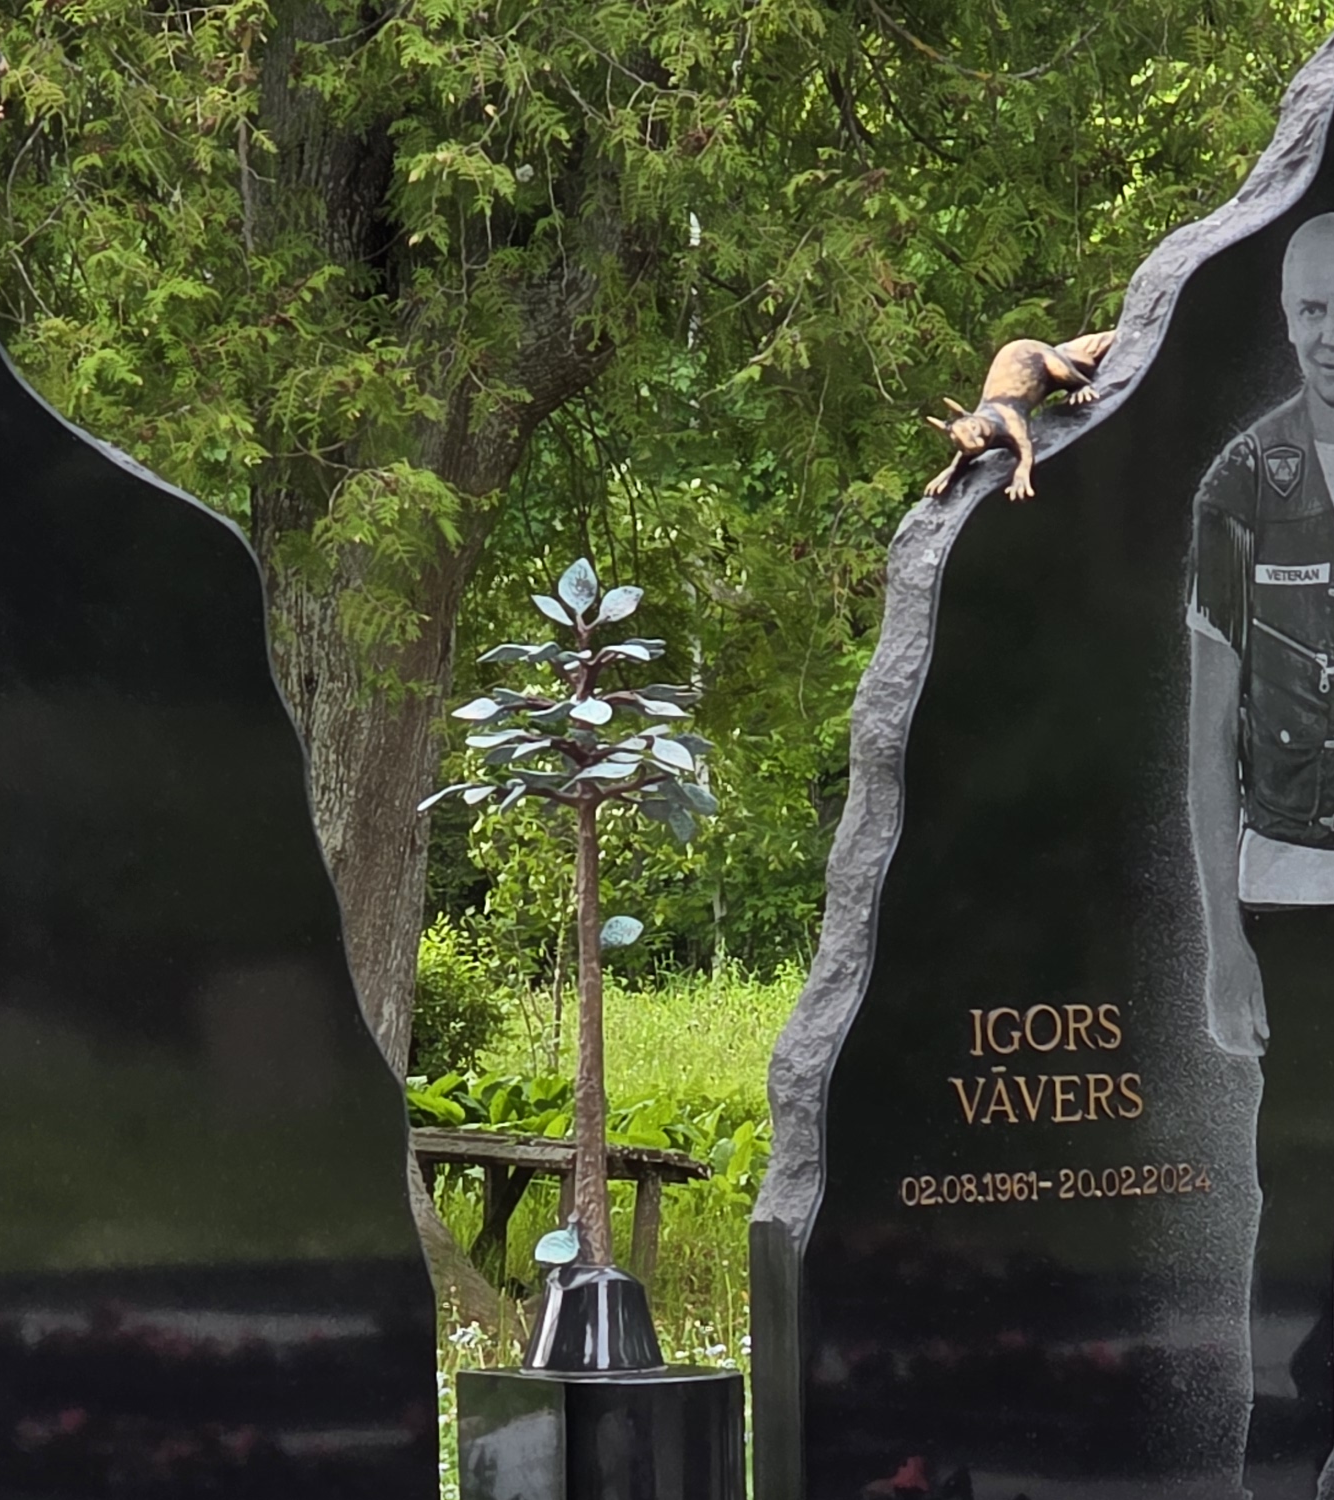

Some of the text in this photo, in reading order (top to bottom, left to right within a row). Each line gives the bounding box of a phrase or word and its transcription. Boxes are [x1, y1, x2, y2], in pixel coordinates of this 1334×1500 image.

[1266, 569, 1320, 581] VETERAN
[969, 1004, 1122, 1056] IGORS
[948, 1066, 1144, 1125] VĀVERS
